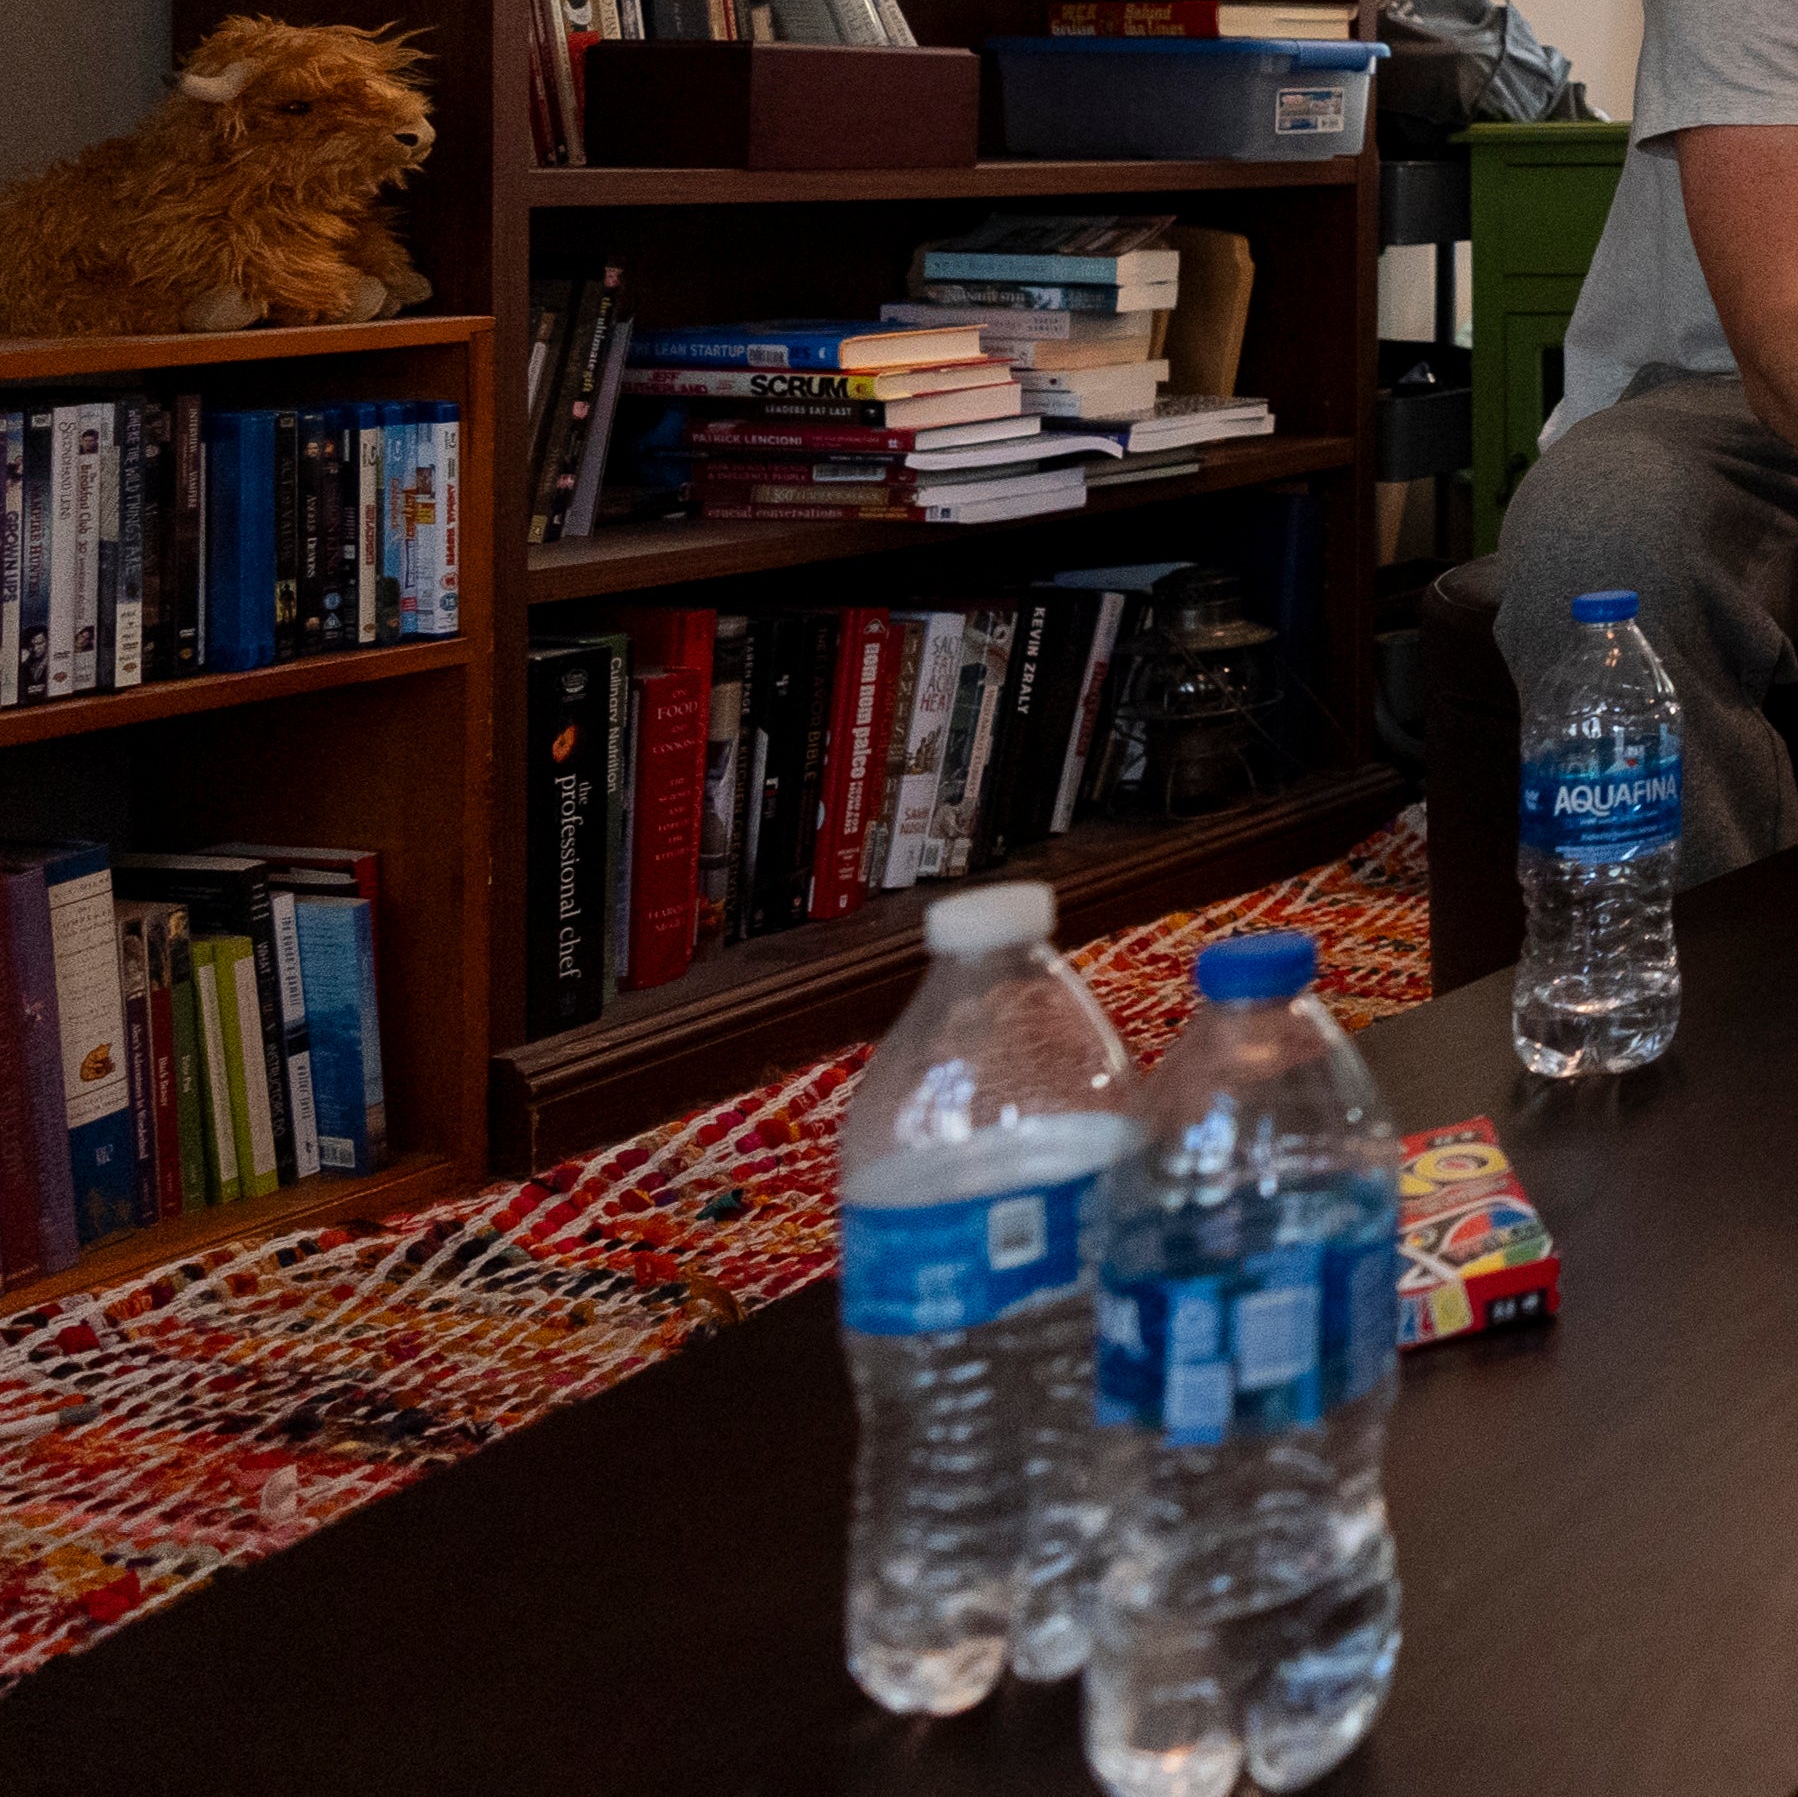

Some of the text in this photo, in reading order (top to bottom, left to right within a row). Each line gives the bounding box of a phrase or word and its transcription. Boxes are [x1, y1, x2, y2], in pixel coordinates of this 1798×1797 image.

[581, 297, 612, 392] the ultimate gift
[654, 343, 687, 356] LEAN
[690, 344, 746, 358] STARTUP
[650, 372, 678, 383] JEFF
[751, 375, 849, 398] SCRUM
[765, 405, 852, 417] LEADERS EAT LAST
[187, 407, 198, 508] INTERVIEW VAMPIRE
[691, 433, 741, 445] PATRICK
[744, 434, 802, 446] LENCIONI
[78, 464, 93, 510] Breakfast
[125, 409, 140, 574] WHERE THE WILD THINGS ARE
[78, 512, 92, 535] Club
[707, 506, 843, 519] crucial conversations
[2, 512, 18, 602] GROWN UPS
[29, 483, 42, 599] VAMPIRE HUNTER
[306, 537, 317, 579] DEMONS
[815, 626, 829, 652] THE
[1016, 605, 1048, 715] KEVIN ZRALY
[741, 636, 756, 716] KAREN PAGE
[807, 653, 827, 727] FLAVOR
[607, 657, 622, 794] Culinary Nutrition
[657, 701, 698, 720] FOOD
[850, 642, 881, 780] nom nom paleo
[804, 729, 823, 782] BIBLE
[578, 781, 591, 806] the
[843, 781, 856, 836] HUMANS
[1553, 774, 1678, 817] AQUAFINA
[725, 746, 749, 913] KITCHEN CREATIVITY
[555, 774, 582, 980] professional chef
[256, 940, 271, 975] WHAT
[131, 1023, 142, 1051] Alice's
[133, 1052, 144, 1098] Adventures
[158, 1056, 169, 1107] Black Beauty
[266, 1042, 283, 1116] INSTRUCTORS
[137, 1109, 149, 1160] Wonderland
[273, 1117, 285, 1137] DO
